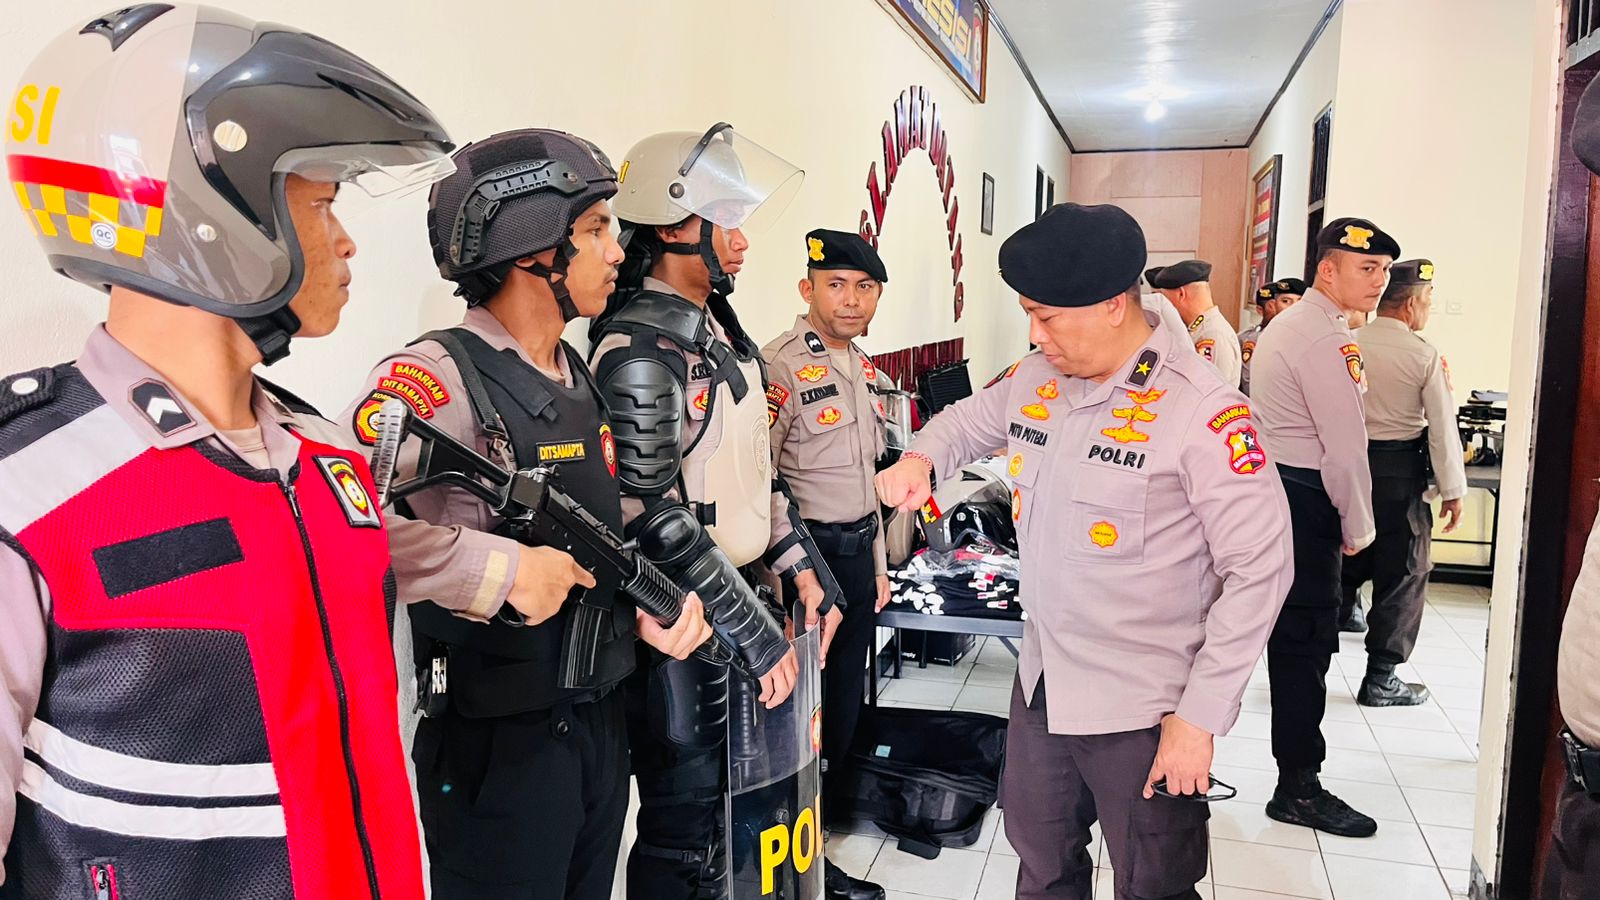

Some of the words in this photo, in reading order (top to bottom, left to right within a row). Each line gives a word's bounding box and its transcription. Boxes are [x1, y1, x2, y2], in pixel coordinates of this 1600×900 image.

[922, 0, 972, 61] ESISI
[5, 83, 61, 145] SI
[96, 229, 111, 239] QC
[395, 365, 445, 401] BAHARKAM
[1211, 407, 1249, 429] BAHARKAM
[540, 443, 585, 460] DITSAMAPTA
[1088, 445, 1146, 469] POLRI
